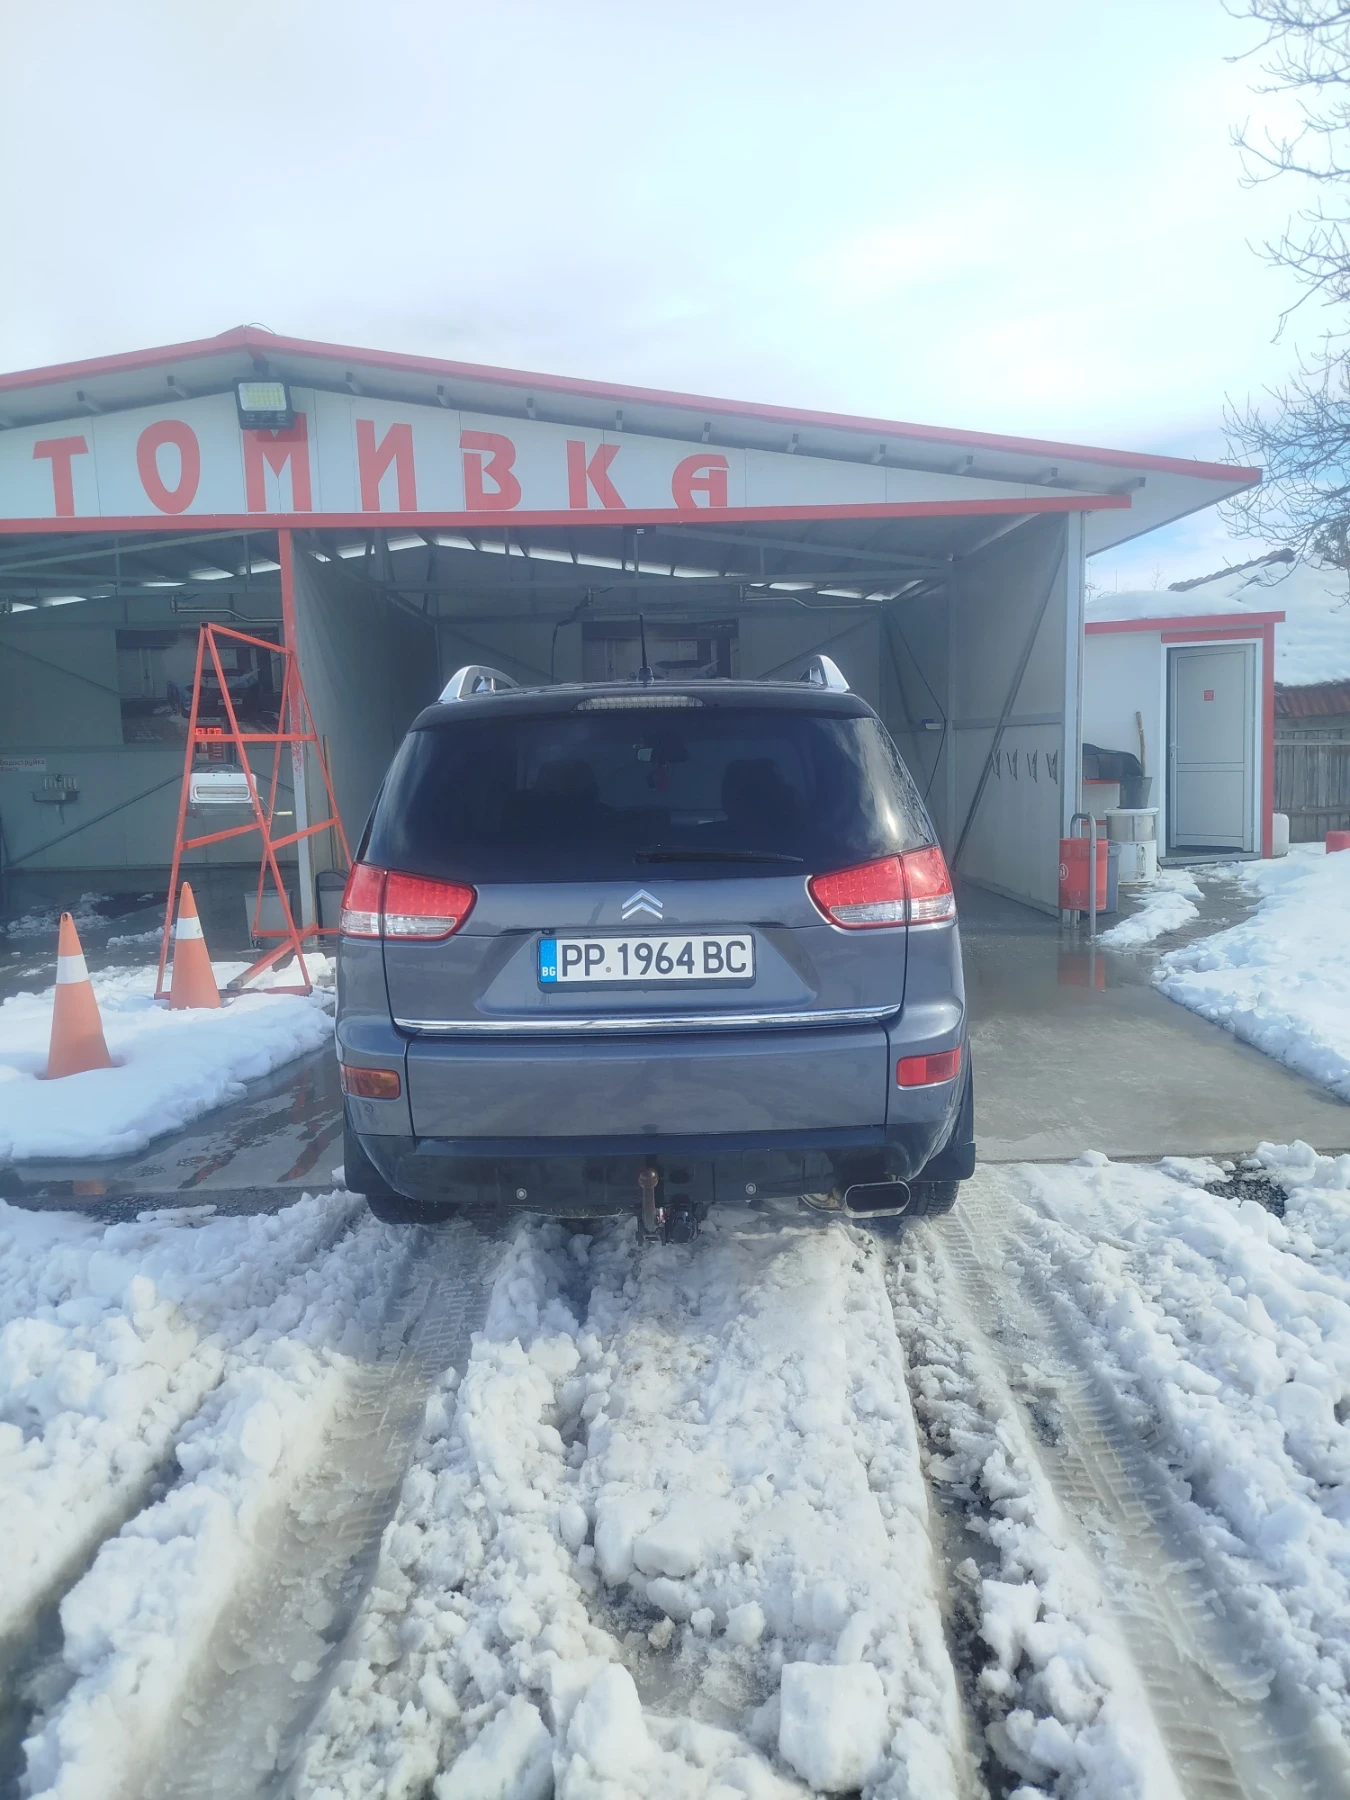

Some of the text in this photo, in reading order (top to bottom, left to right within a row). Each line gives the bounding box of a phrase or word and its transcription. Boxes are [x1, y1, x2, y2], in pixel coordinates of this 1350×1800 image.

[33, 412, 730, 516] ТОМИВКА
[541, 966, 556, 977] BG
[561, 940, 747, 977] PP 1964 BC
